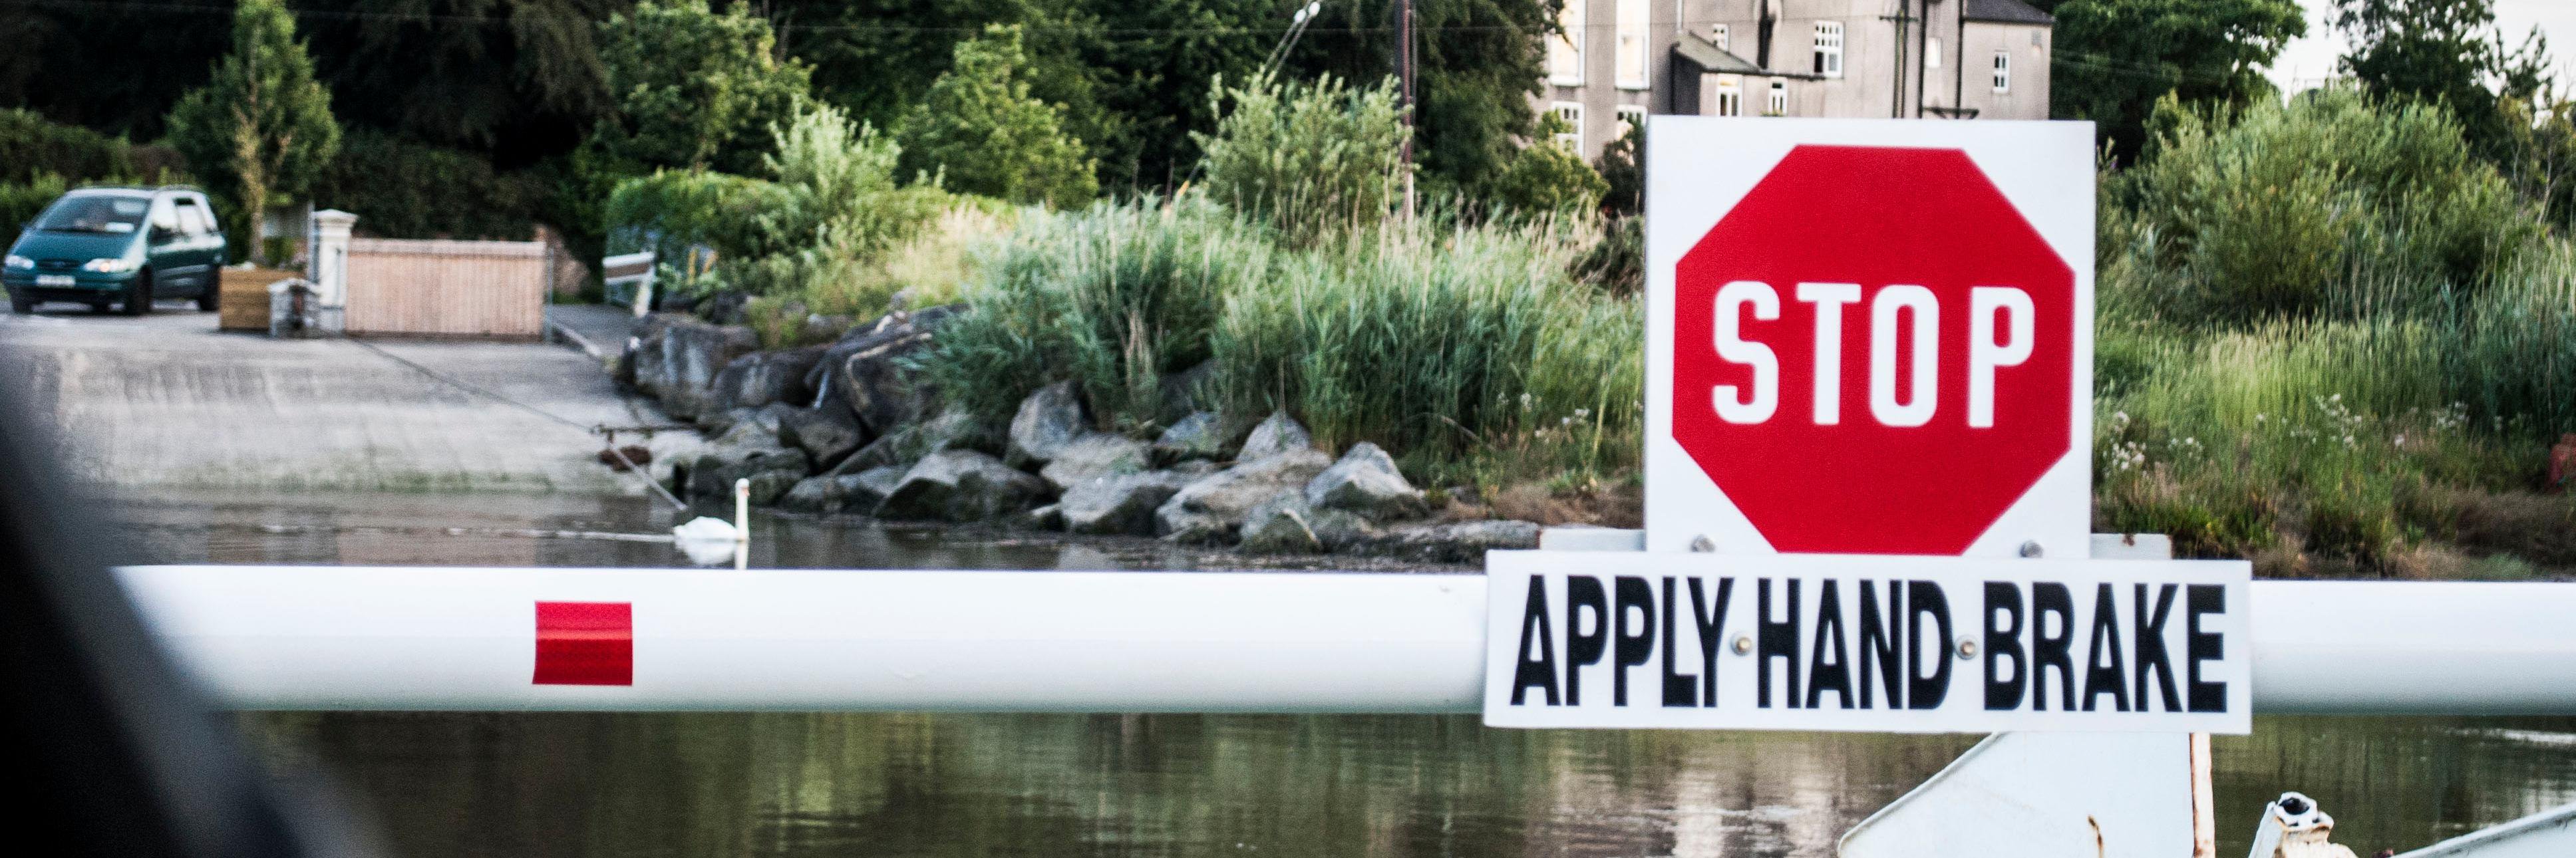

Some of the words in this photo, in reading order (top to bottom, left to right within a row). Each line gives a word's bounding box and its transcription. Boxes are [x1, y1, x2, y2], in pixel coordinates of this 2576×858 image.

[1711, 279, 2036, 428] STOP
[1510, 573, 1734, 708] APPLY
[1756, 578, 1957, 710] HAND
[1983, 581, 2228, 714] BRAKE
